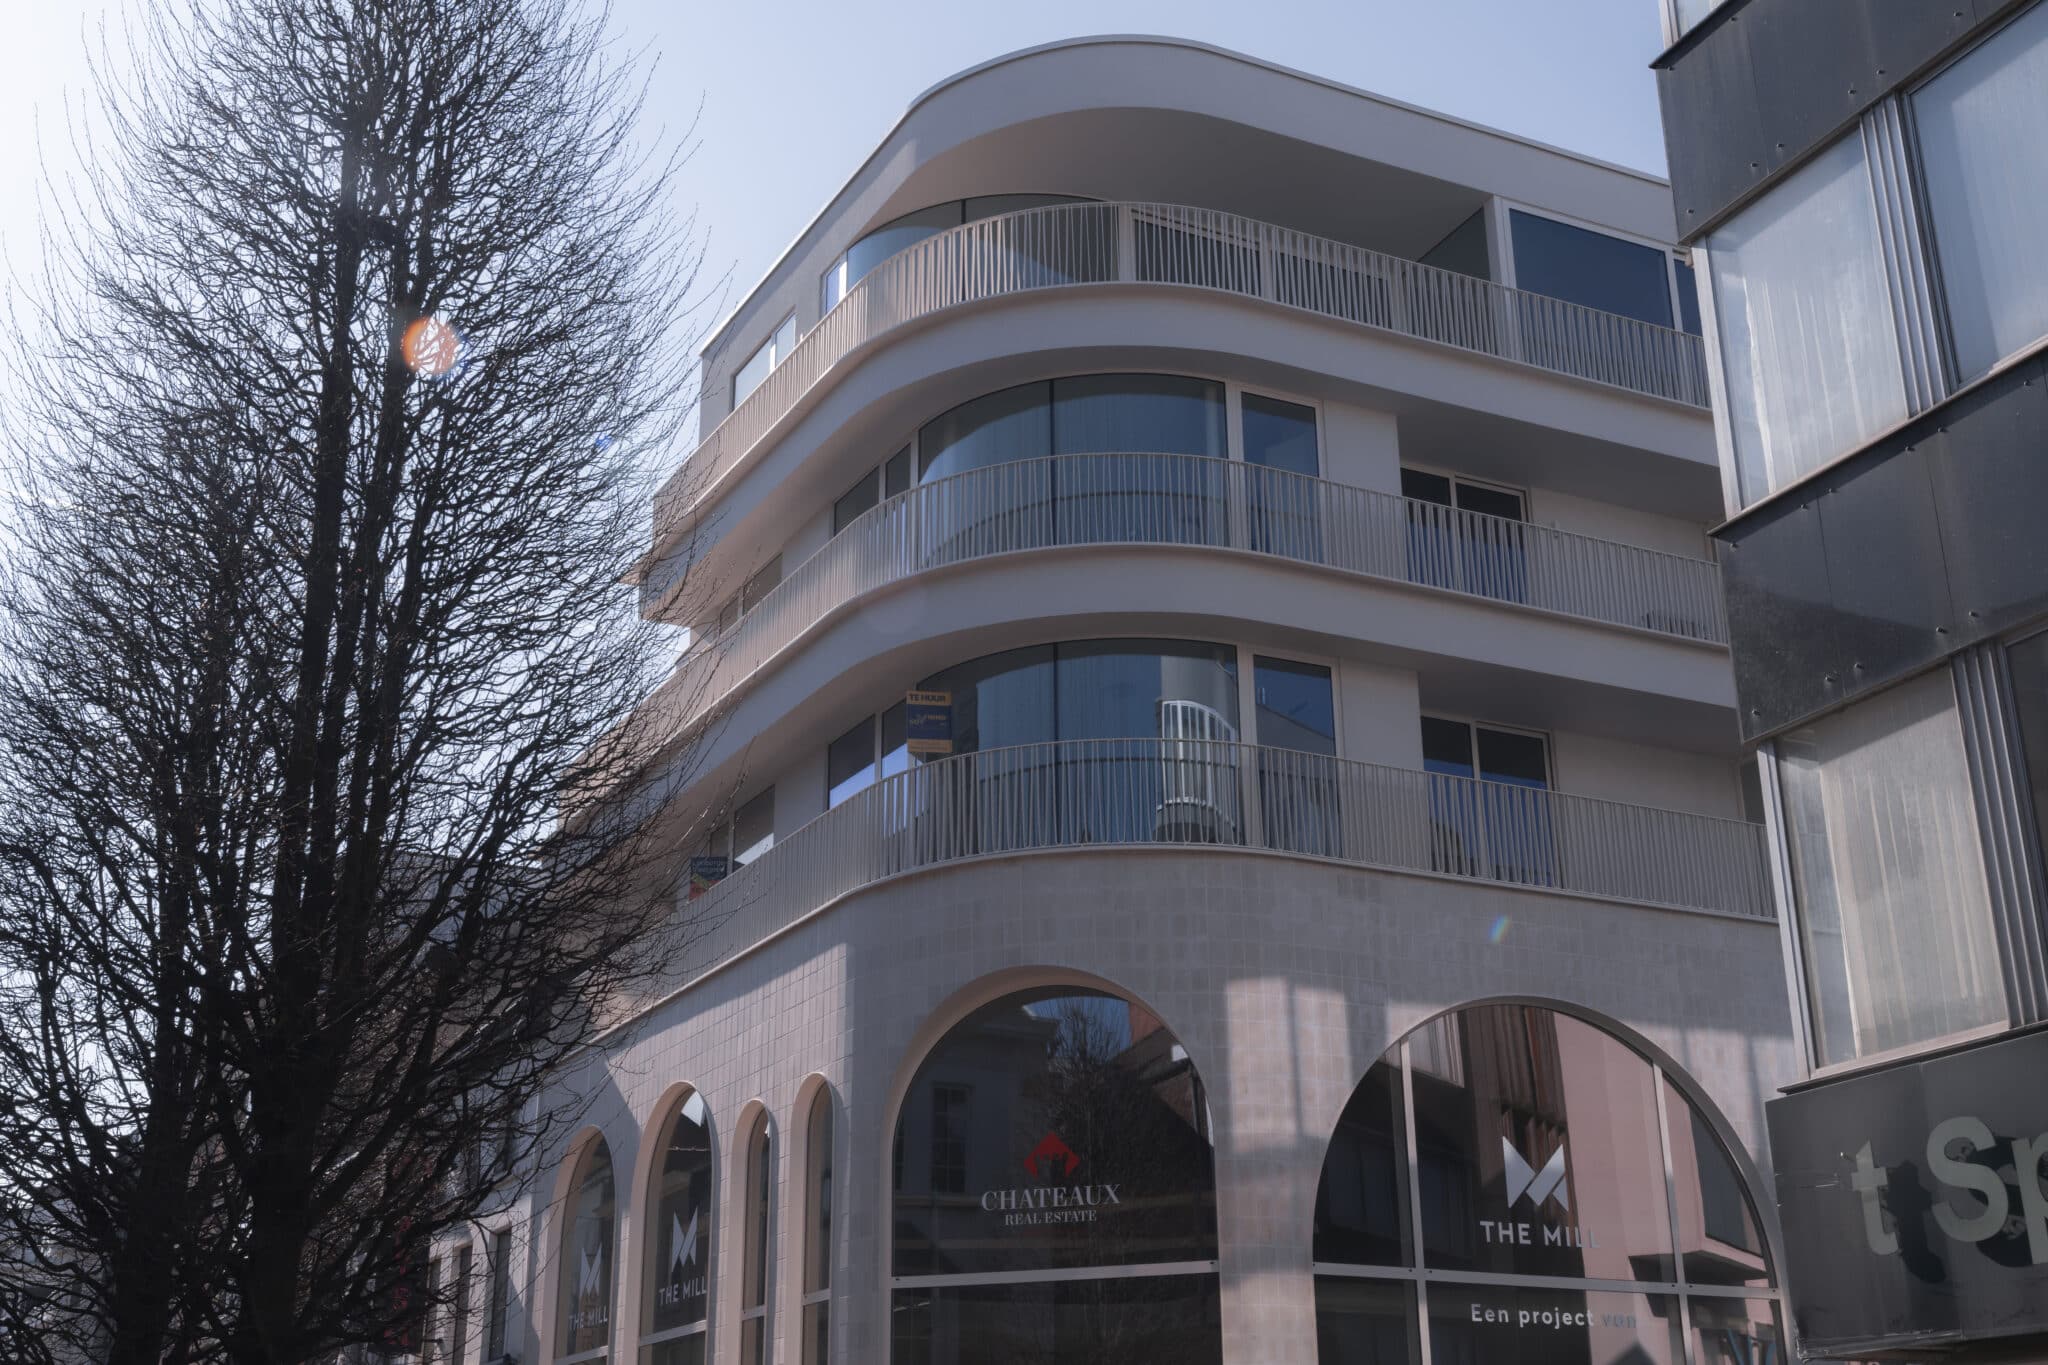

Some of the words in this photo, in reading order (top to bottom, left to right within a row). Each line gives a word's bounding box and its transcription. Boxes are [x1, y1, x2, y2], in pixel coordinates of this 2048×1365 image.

[981, 1183, 1121, 1212] CHATEAUX
[1004, 1212, 1041, 1226] REAL
[1044, 1209, 1097, 1224] ESTATE
[1479, 1220, 1532, 1245] THE
[1543, 1224, 1601, 1249] MILL
[658, 1283, 680, 1306] THE
[683, 1275, 707, 1300] MILL
[1470, 1303, 1510, 1323] Een
[1518, 1306, 1595, 1330] project
